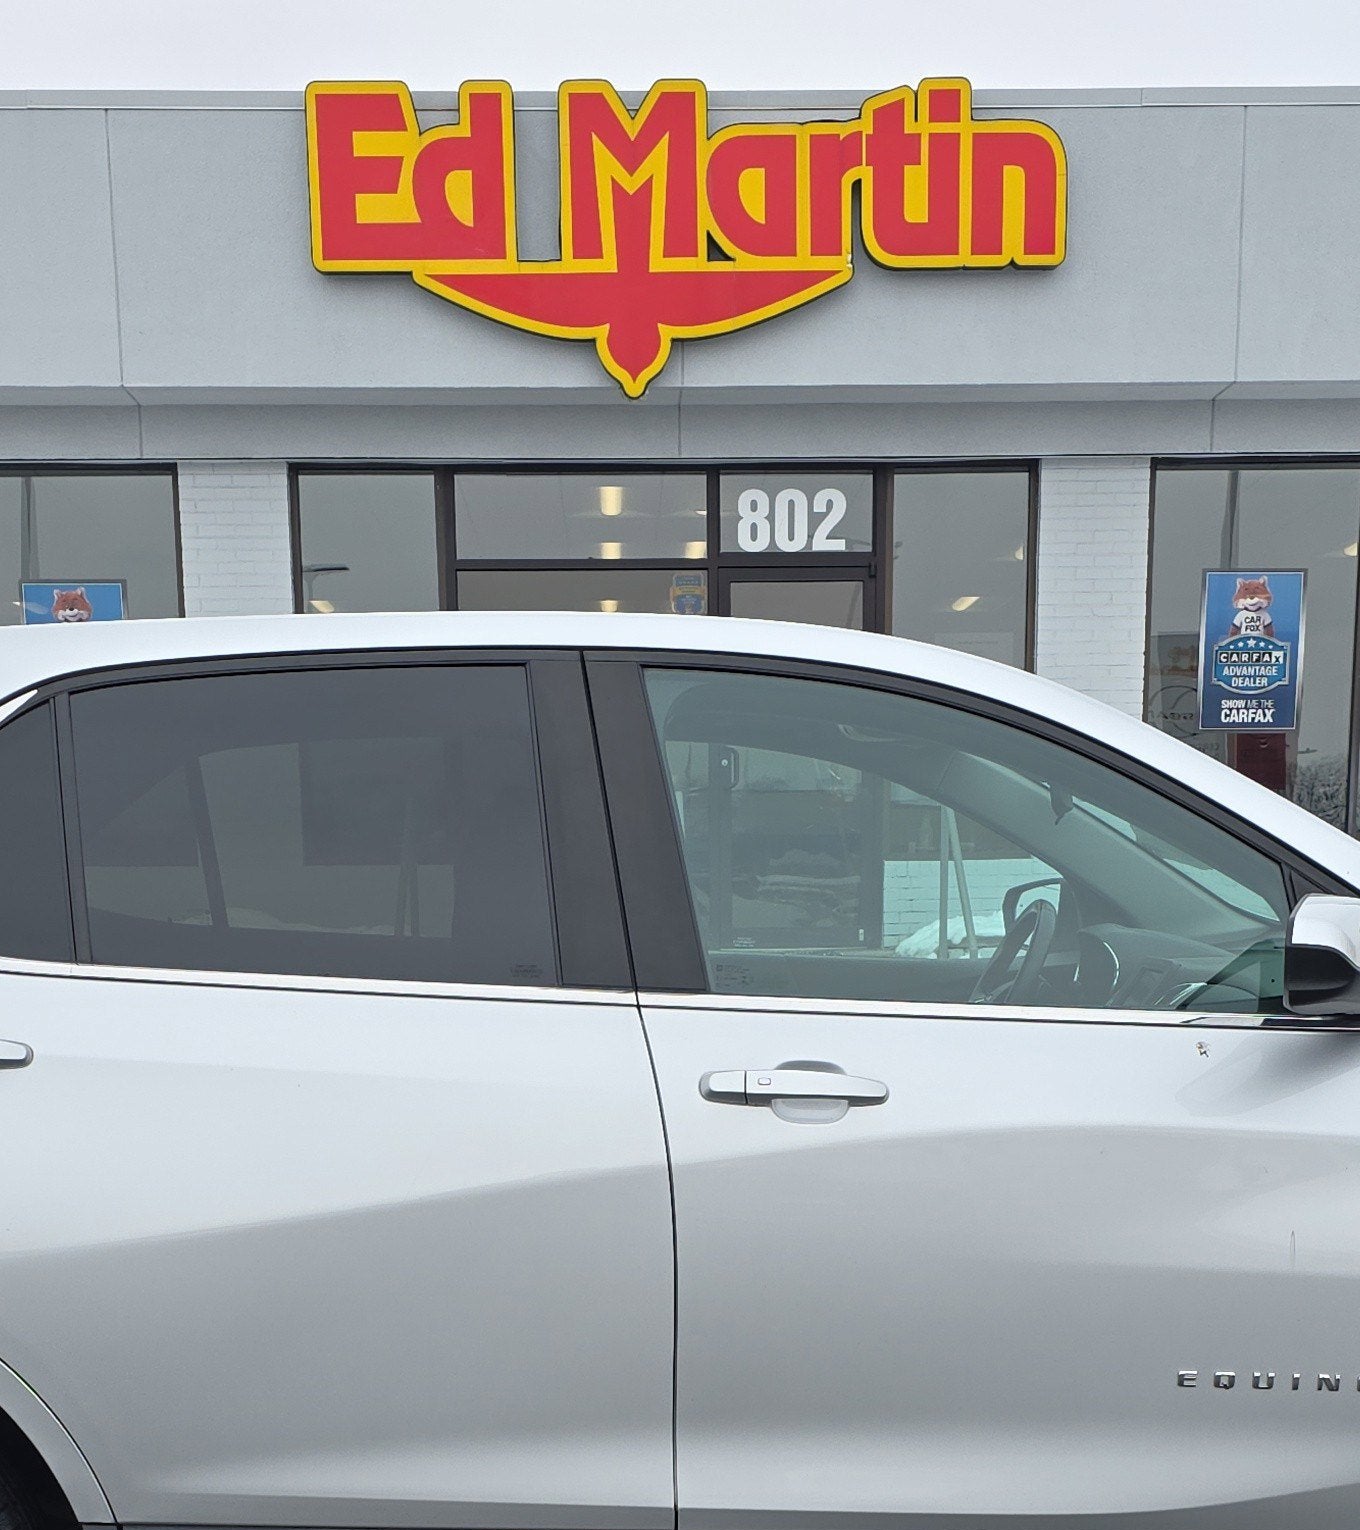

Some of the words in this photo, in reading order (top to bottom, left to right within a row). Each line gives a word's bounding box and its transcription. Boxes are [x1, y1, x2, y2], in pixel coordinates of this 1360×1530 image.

[305, 80, 517, 275] Ed
[558, 77, 1068, 270] Martin
[737, 488, 847, 553] 802
[1244, 616, 1261, 625] CAR
[1244, 624, 1261, 632] FOX
[1219, 651, 1283, 664] CARFAX
[1223, 665, 1278, 676] ADVANTAGE
[1231, 676, 1268, 687] DEALER
[1221, 700, 1246, 709] SHOW
[1247, 700, 1260, 709] ME
[1261, 700, 1274, 709] THE
[1221, 709, 1275, 723] CARFAX
